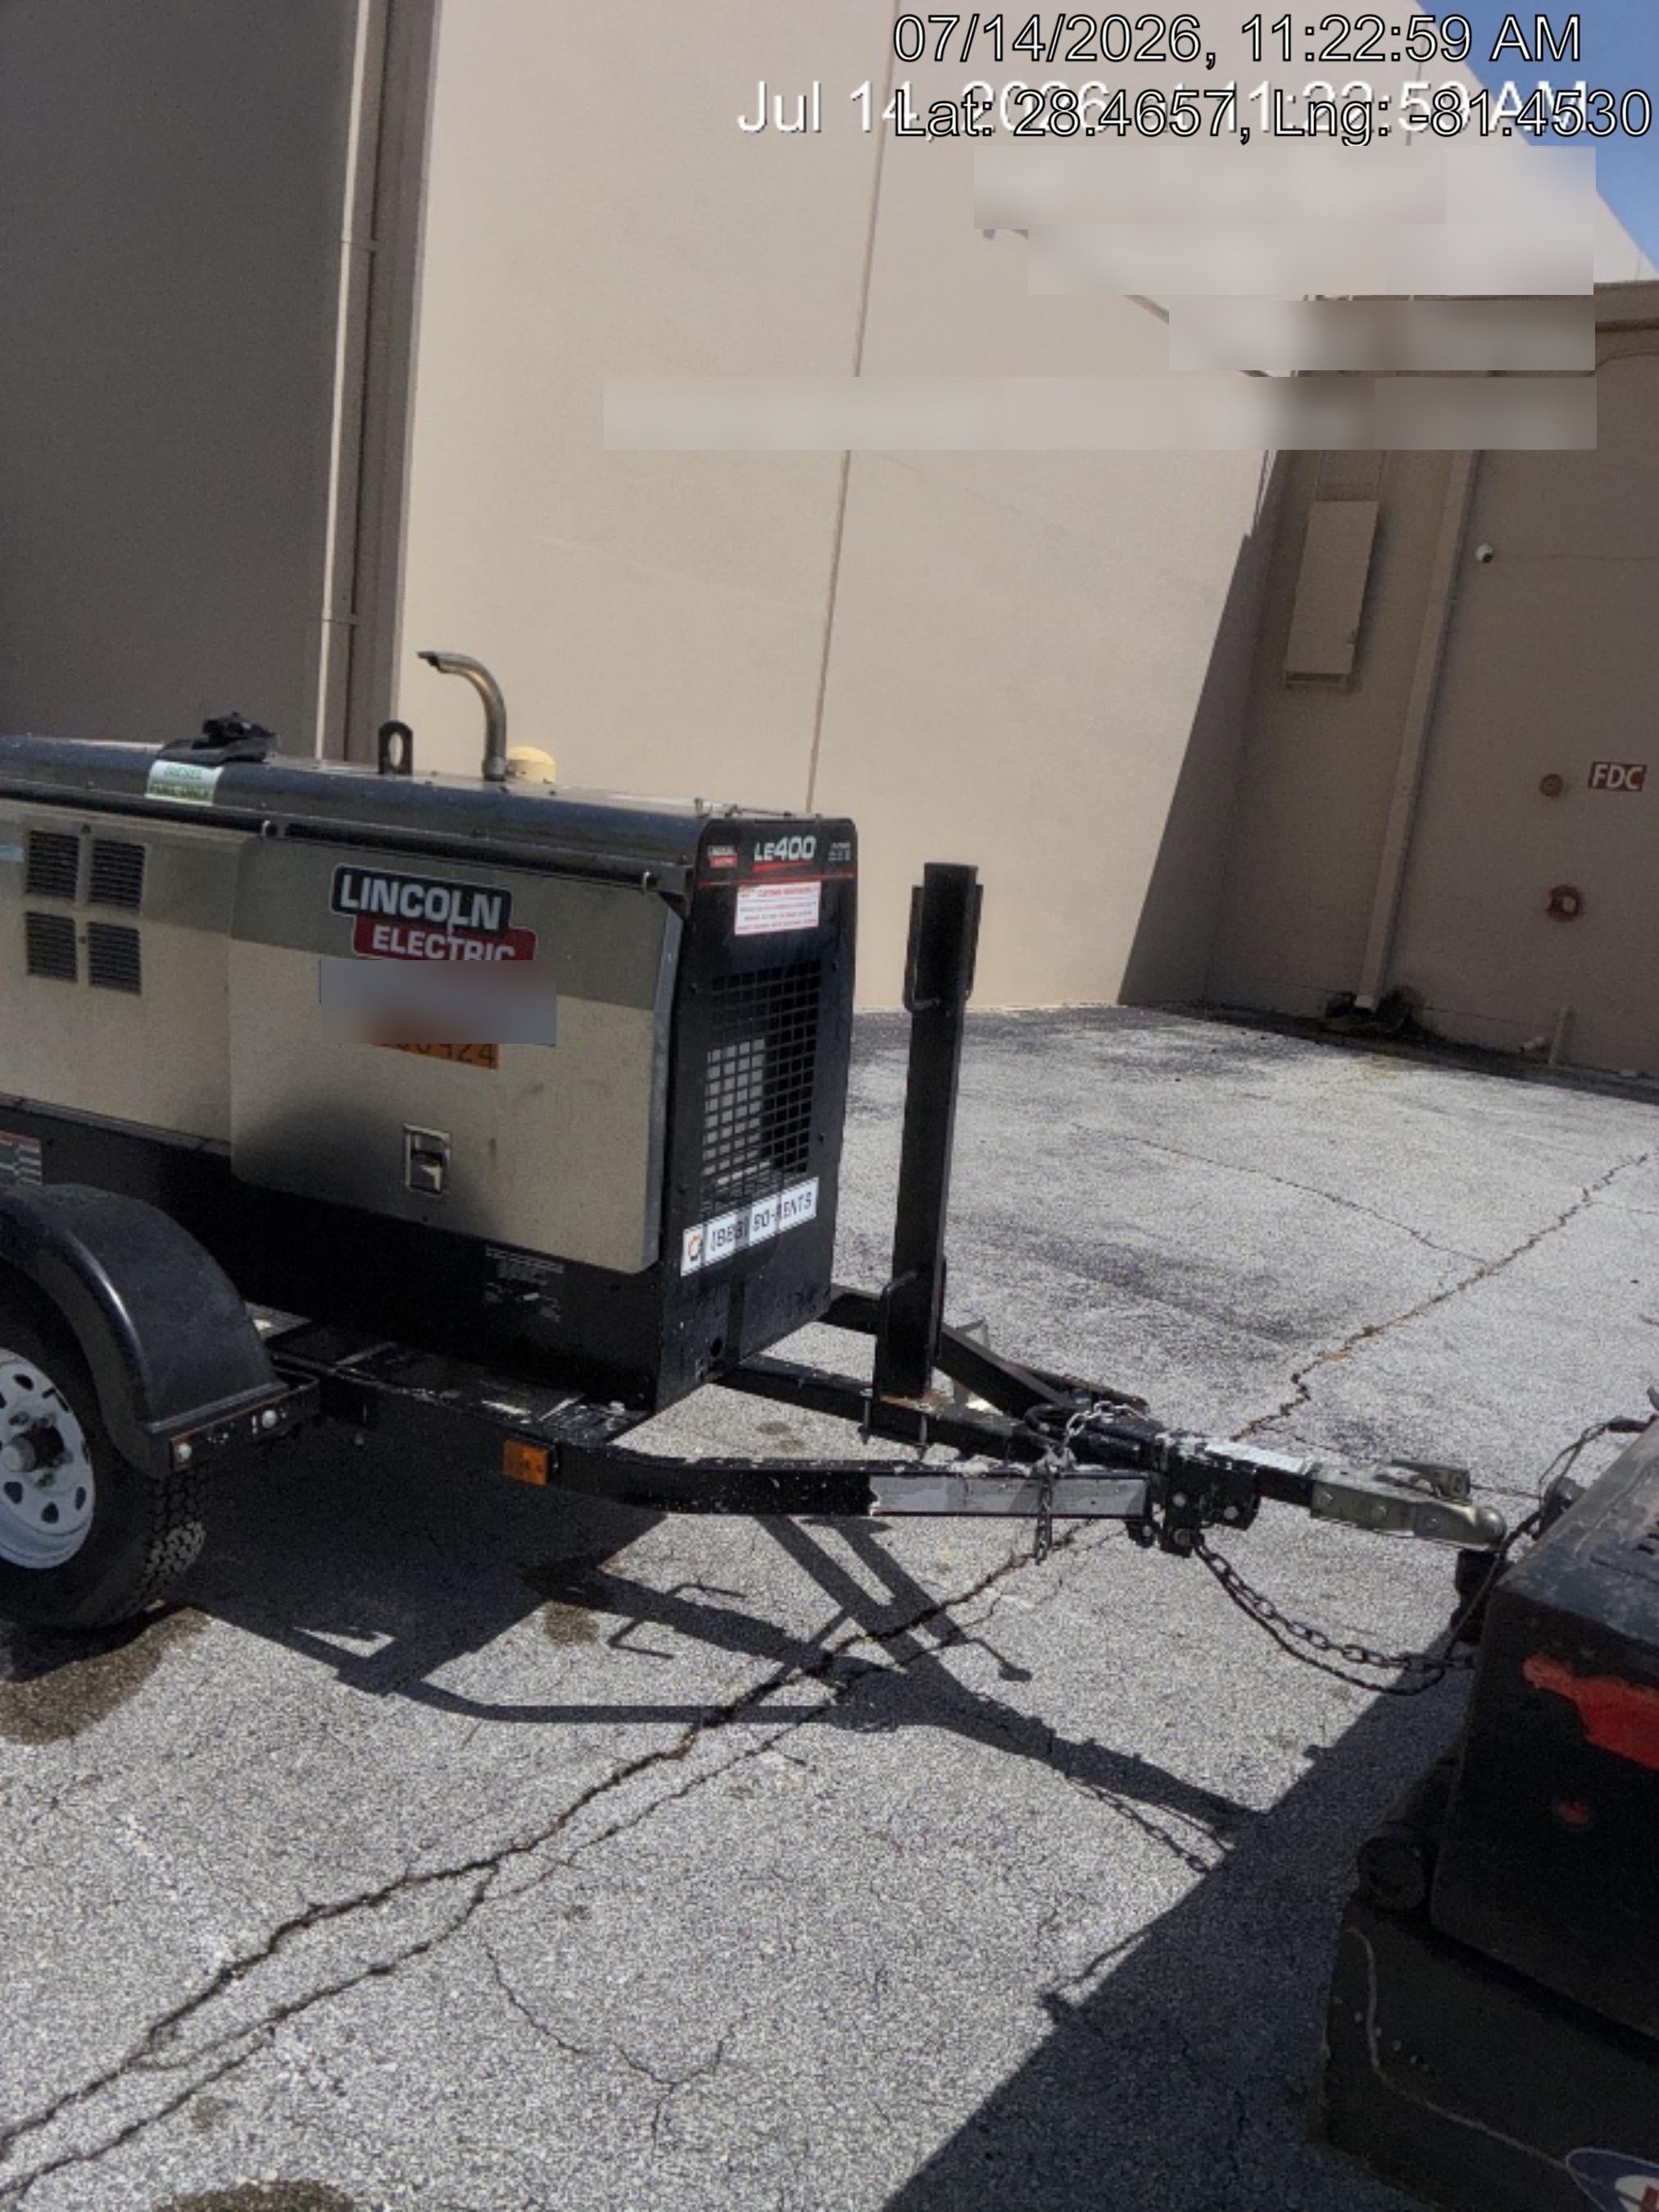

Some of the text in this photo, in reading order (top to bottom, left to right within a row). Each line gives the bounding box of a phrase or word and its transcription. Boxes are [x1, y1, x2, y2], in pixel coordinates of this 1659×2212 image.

[1592, 763, 1643, 791] FDC
[754, 835, 818, 861] LE400
[339, 873, 503, 931] LINCOLN
